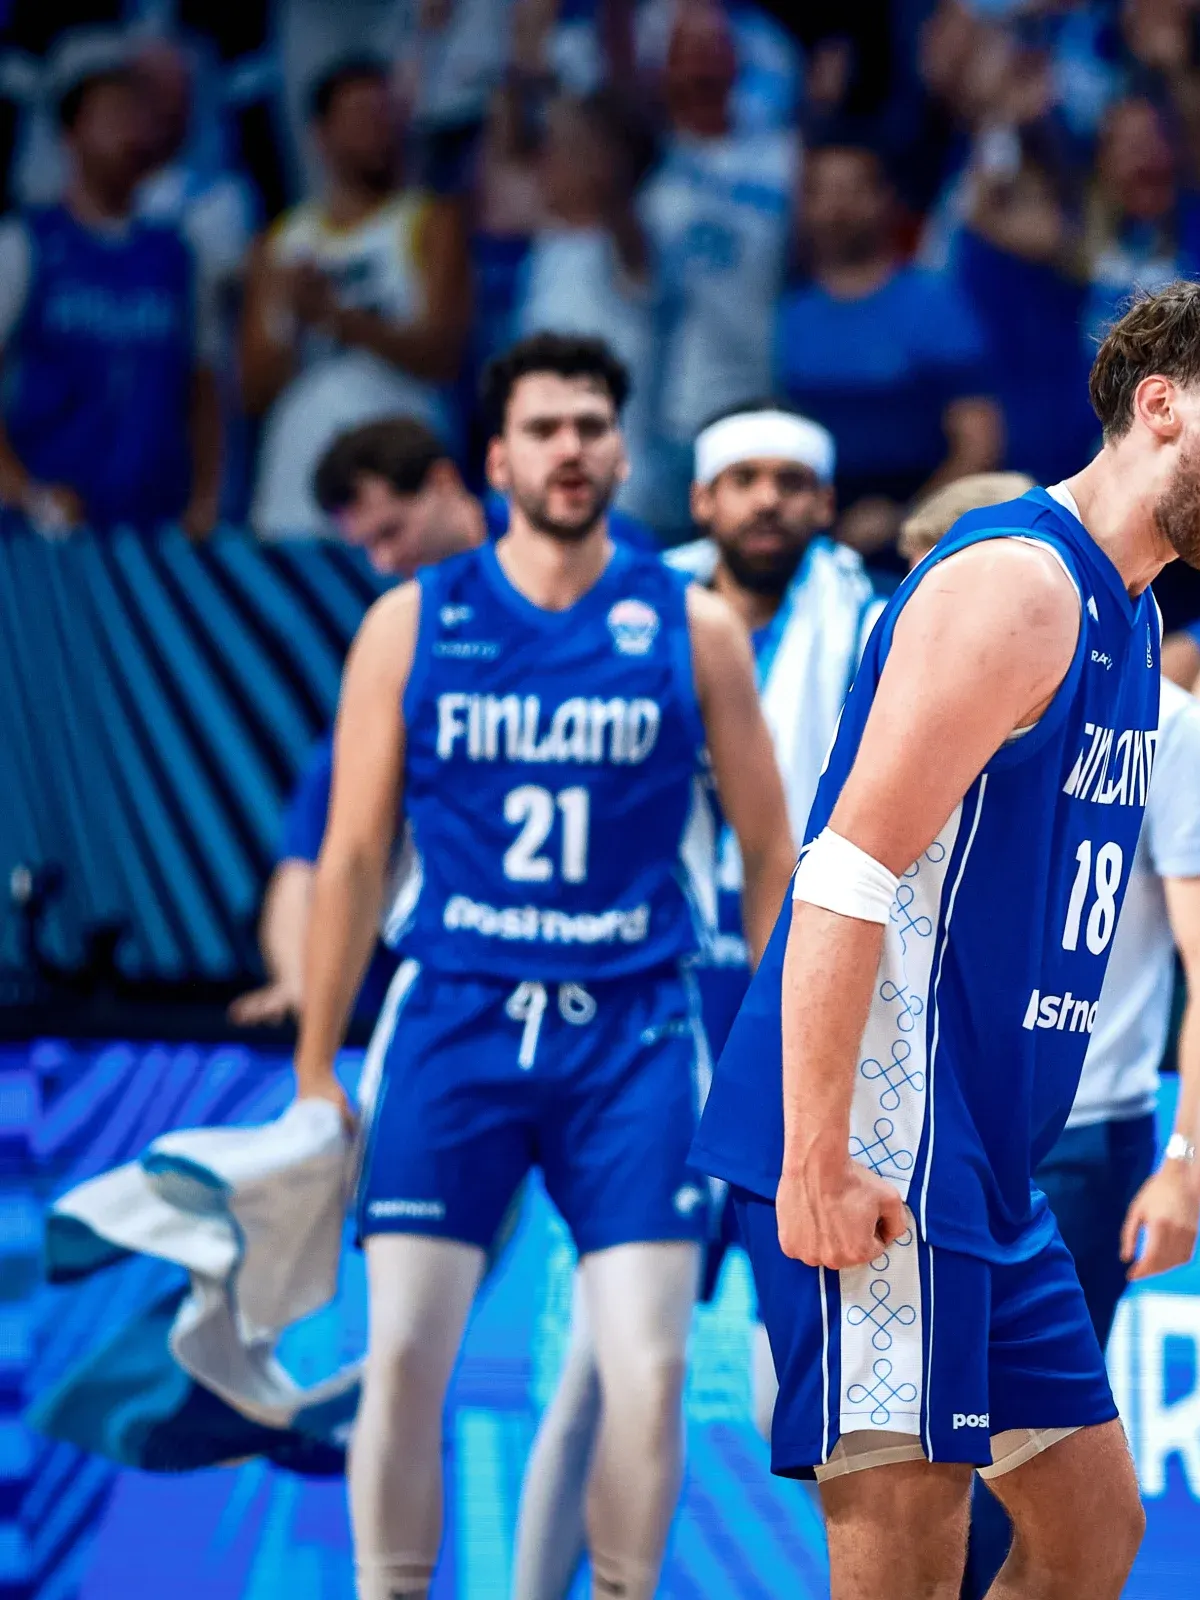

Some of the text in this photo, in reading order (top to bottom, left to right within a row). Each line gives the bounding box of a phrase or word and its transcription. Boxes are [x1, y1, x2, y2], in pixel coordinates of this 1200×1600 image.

[436, 692, 661, 765] FINLAND
[503, 784, 590, 884] 21
[1061, 839, 1124, 956] 18
